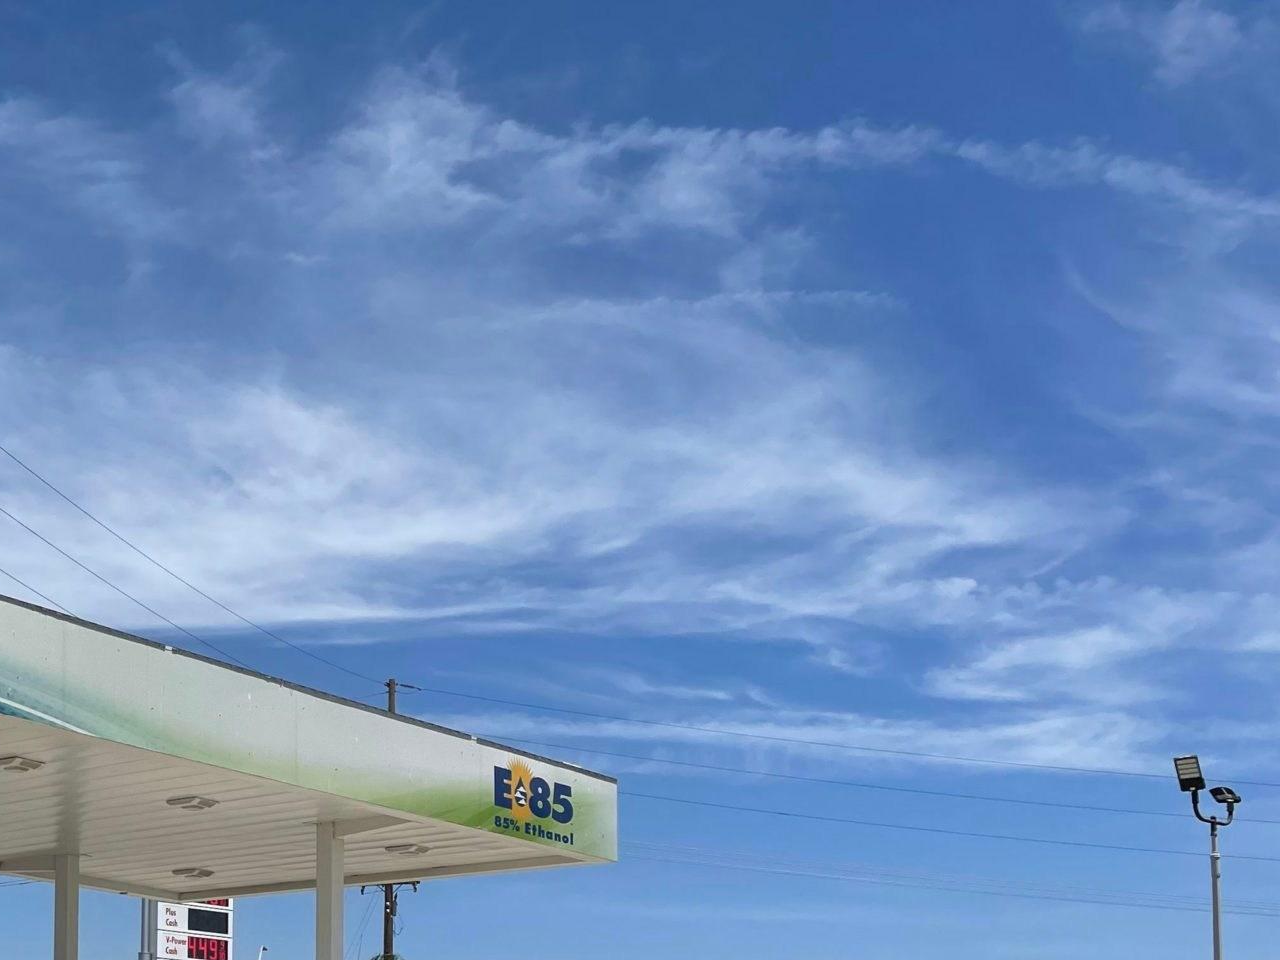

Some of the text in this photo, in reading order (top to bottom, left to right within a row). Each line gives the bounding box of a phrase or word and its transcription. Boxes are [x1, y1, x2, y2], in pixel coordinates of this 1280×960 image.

[494, 815, 574, 845] 85% Ethanol
[165, 907, 177, 917] Plus
[165, 918, 178, 927] Cash
[165, 946, 178, 955] Cash
